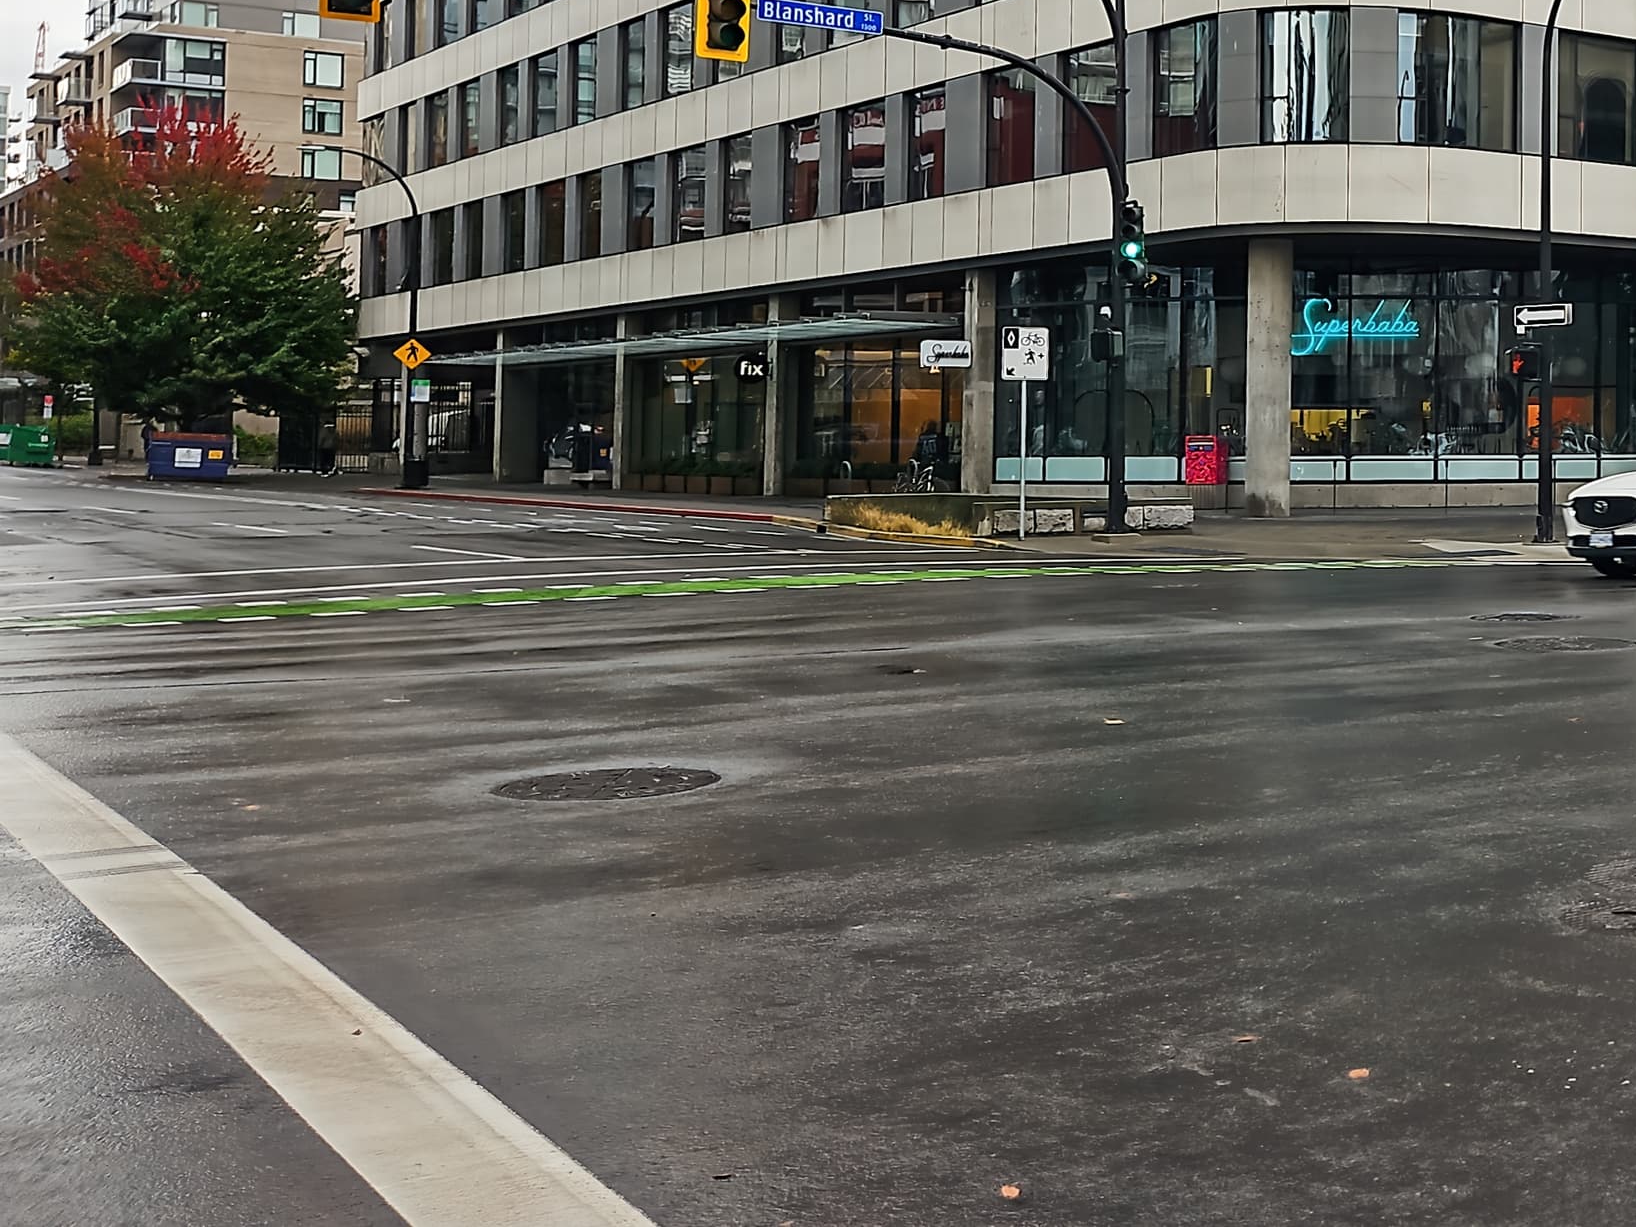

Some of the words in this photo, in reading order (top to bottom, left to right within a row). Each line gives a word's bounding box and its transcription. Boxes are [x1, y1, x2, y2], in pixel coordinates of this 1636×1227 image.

[763, 1, 854, 29] Blanshard
[1291, 298, 1419, 355] Superbaba
[740, 360, 764, 376] fix
